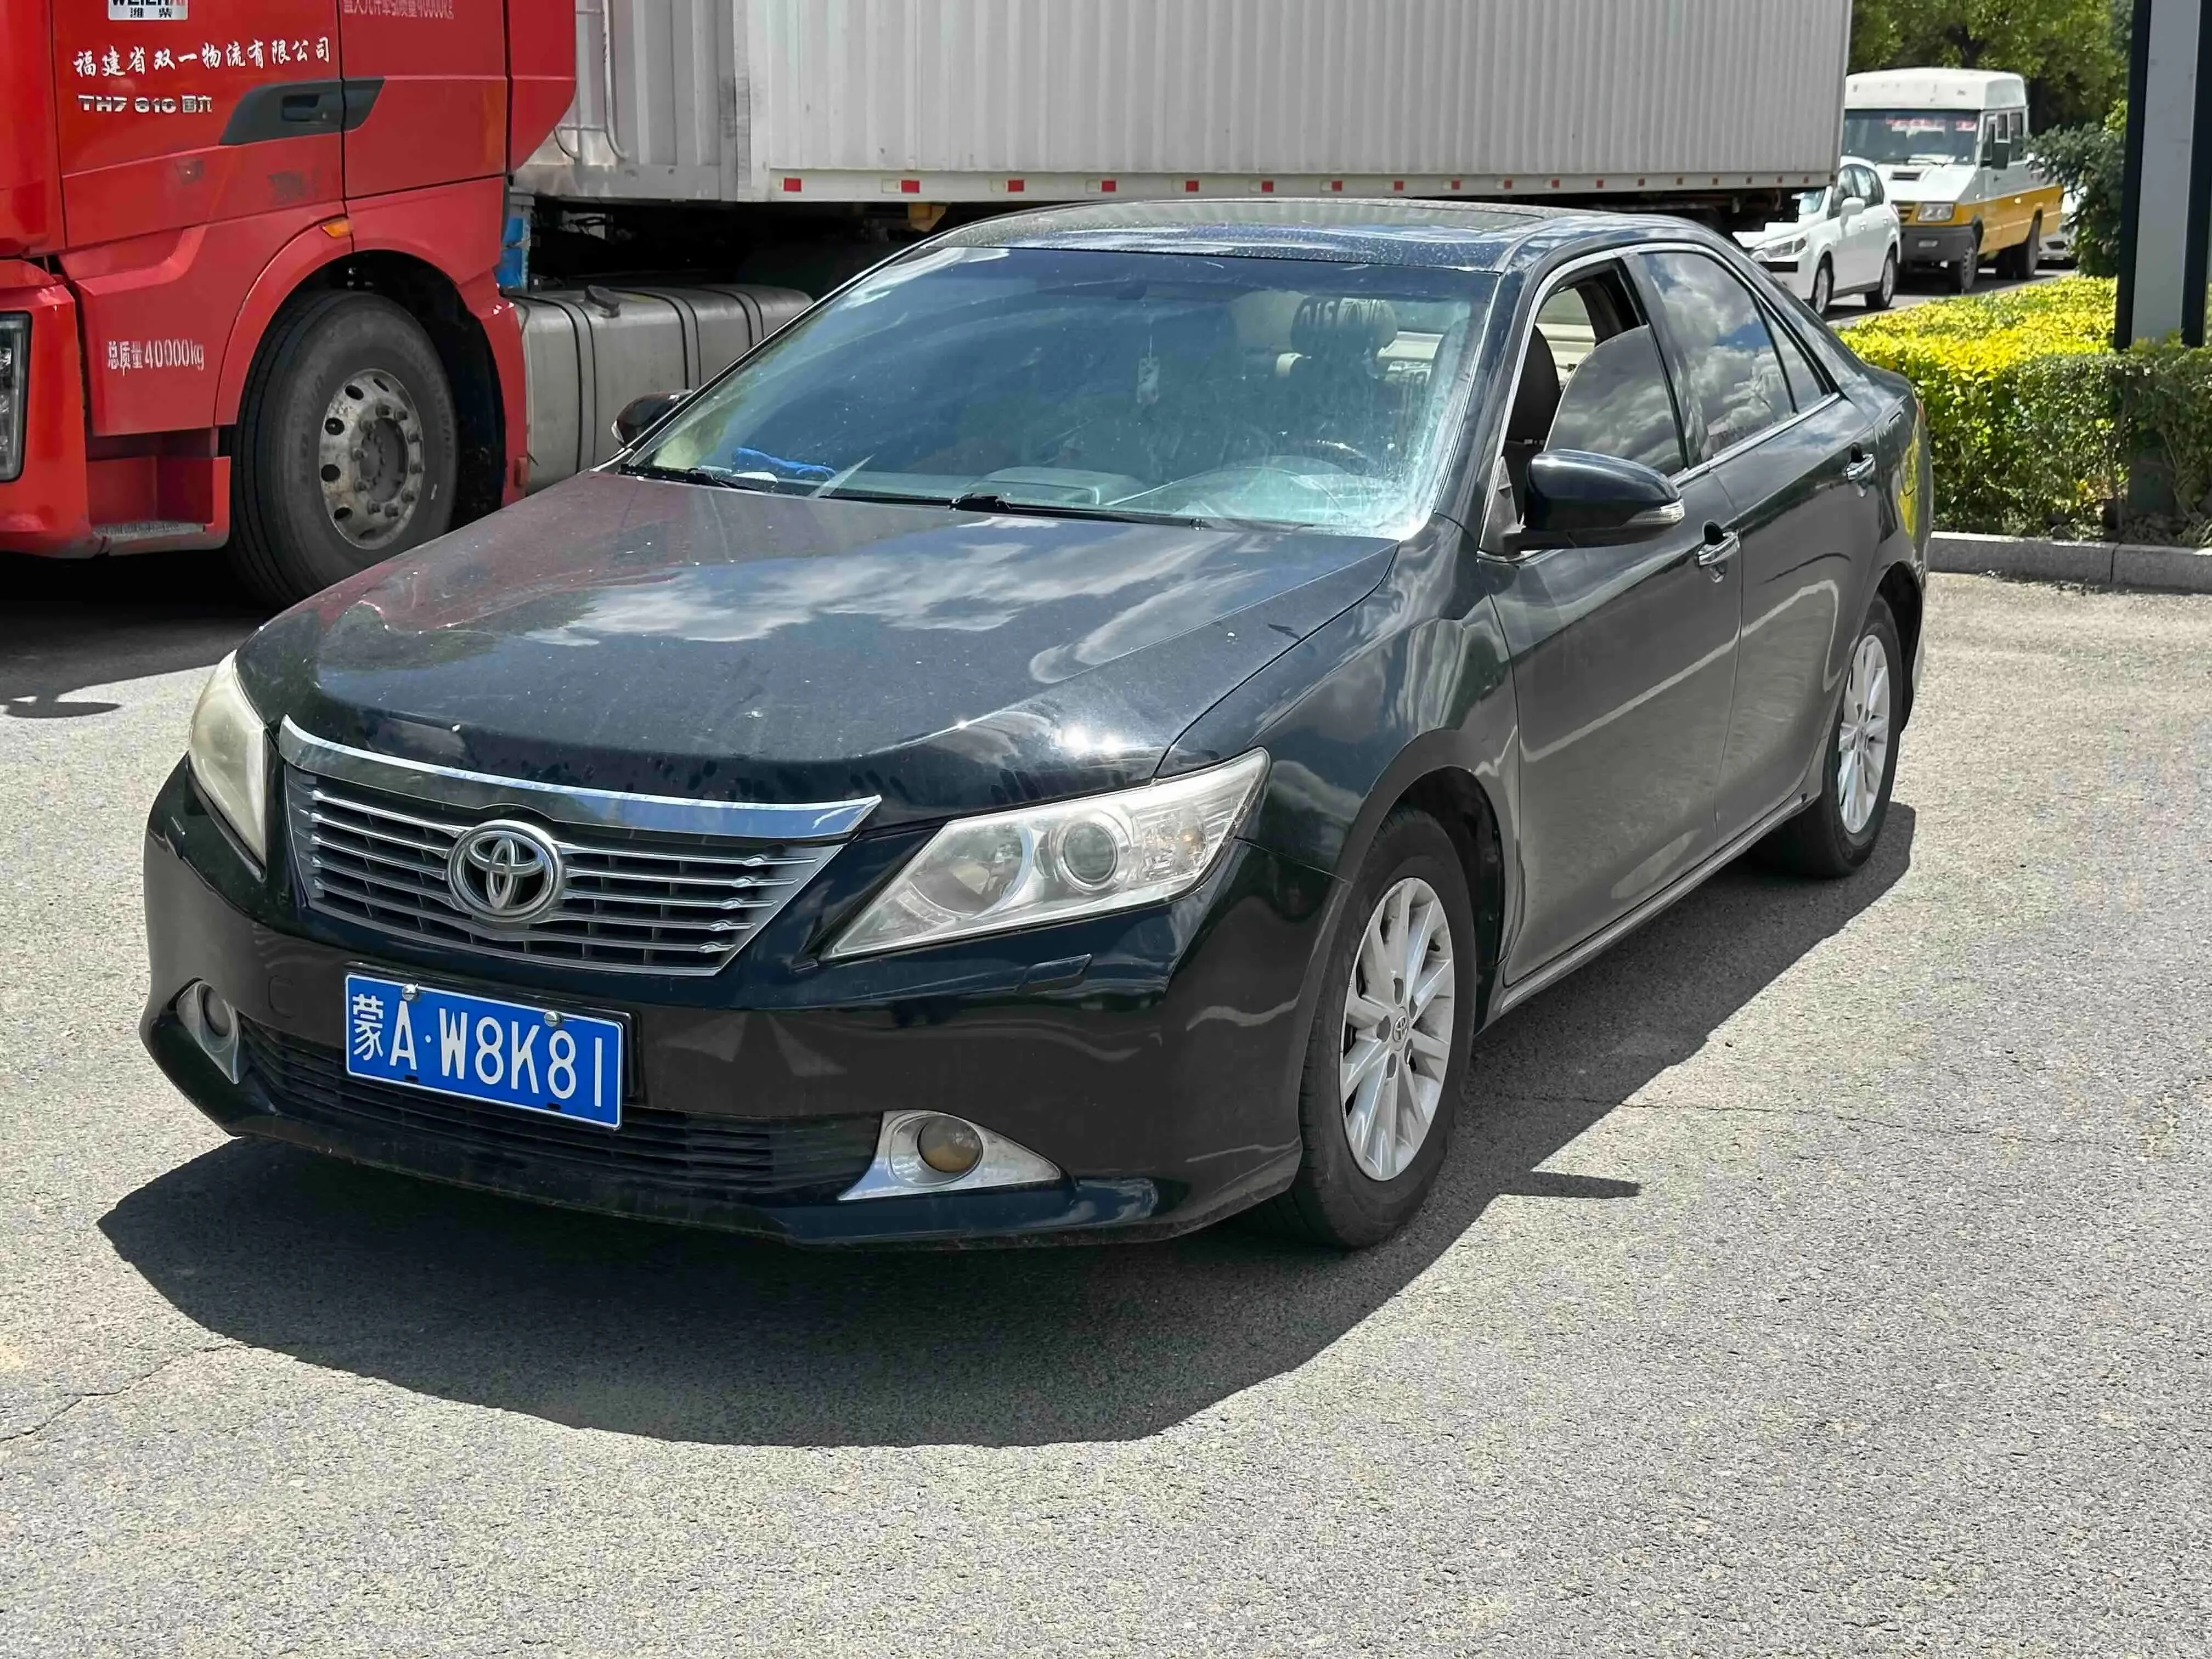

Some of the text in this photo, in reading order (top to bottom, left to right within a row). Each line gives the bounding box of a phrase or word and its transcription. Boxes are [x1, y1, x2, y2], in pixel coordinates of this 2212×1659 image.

[73, 37, 330, 77] 福建省双一物流有限公司
[78, 95, 128, 112] TH7
[181, 95, 213, 113] 国六
